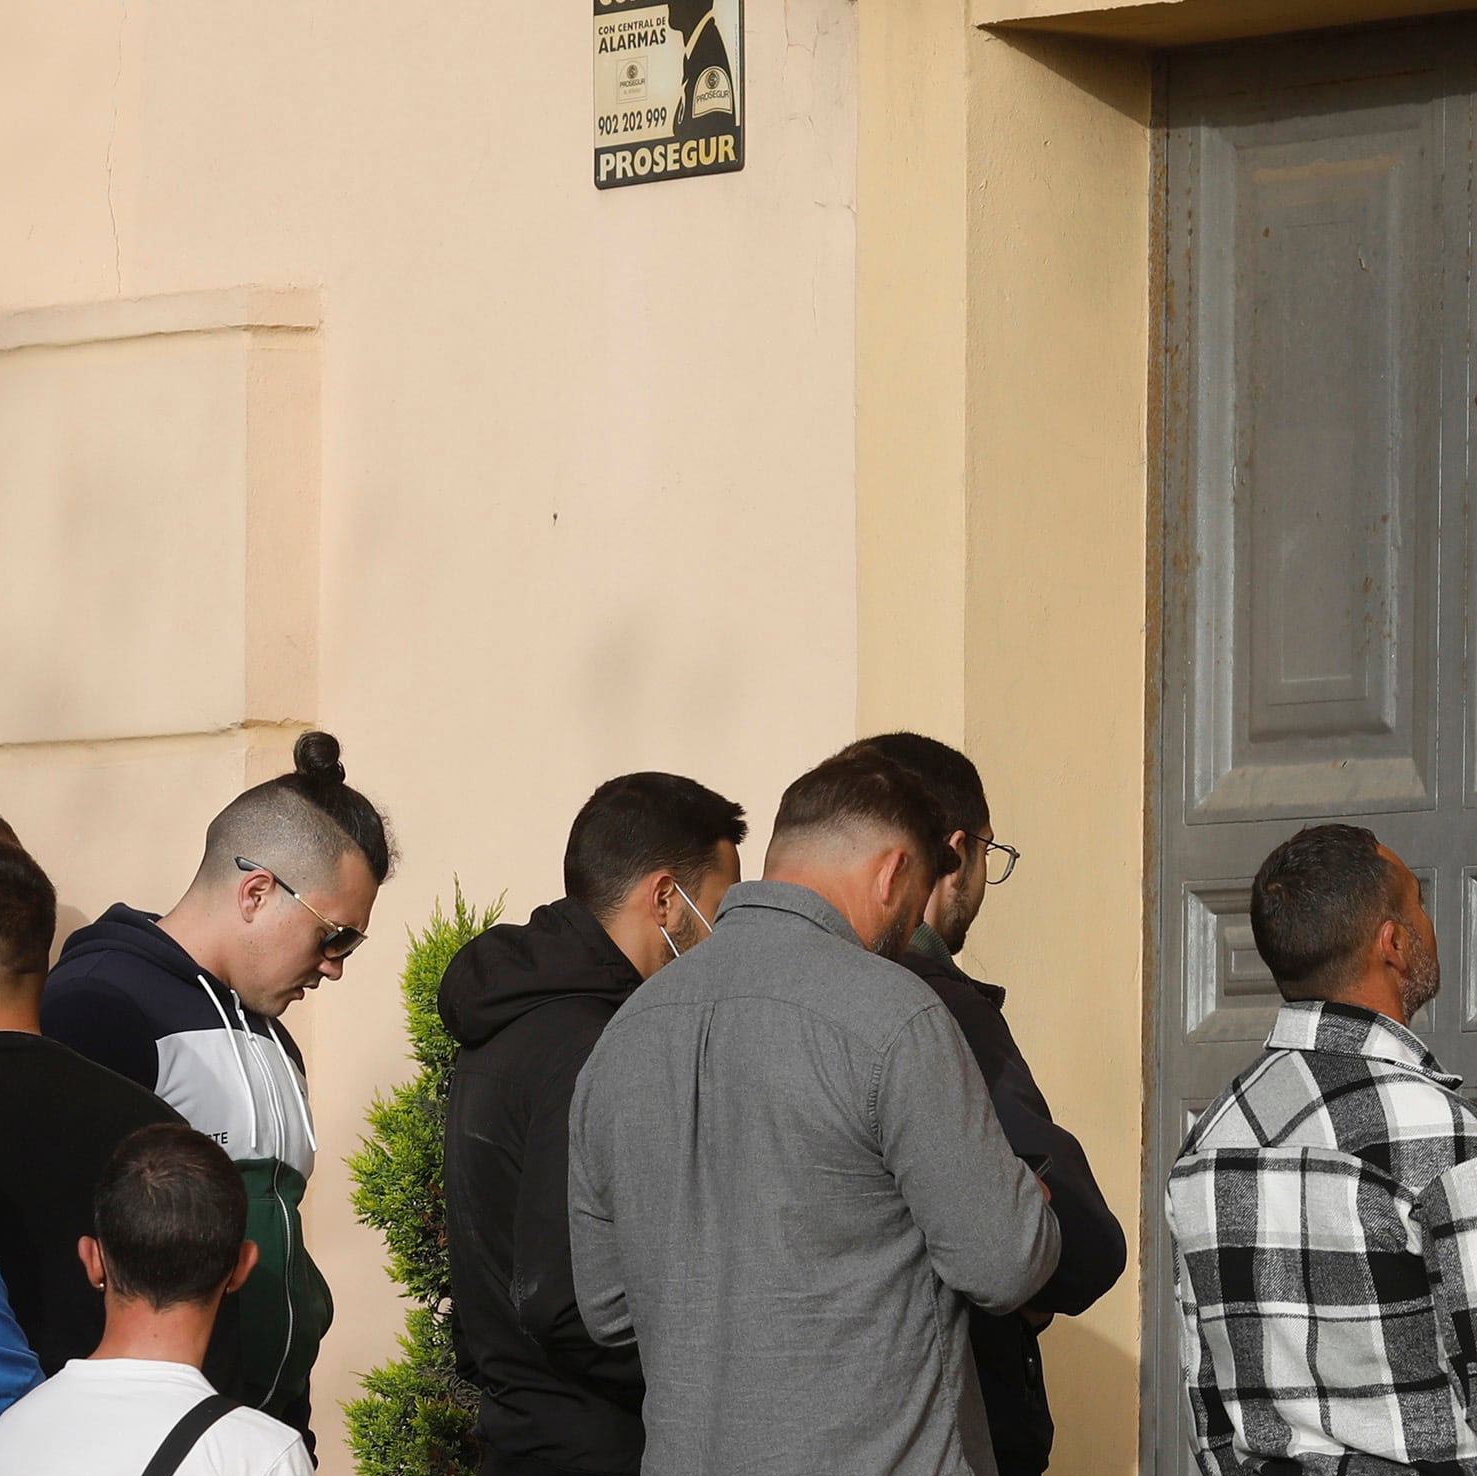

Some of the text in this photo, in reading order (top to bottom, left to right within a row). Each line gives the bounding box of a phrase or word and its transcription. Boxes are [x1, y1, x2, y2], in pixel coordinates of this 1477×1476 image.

[598, 16, 666, 35] CON CENTRAL DE
[599, 28, 666, 54] ALARMAS
[696, 90, 730, 103] PROSEGUR
[598, 106, 667, 136] 902 202 999
[599, 134, 736, 182] PROSEGUR
